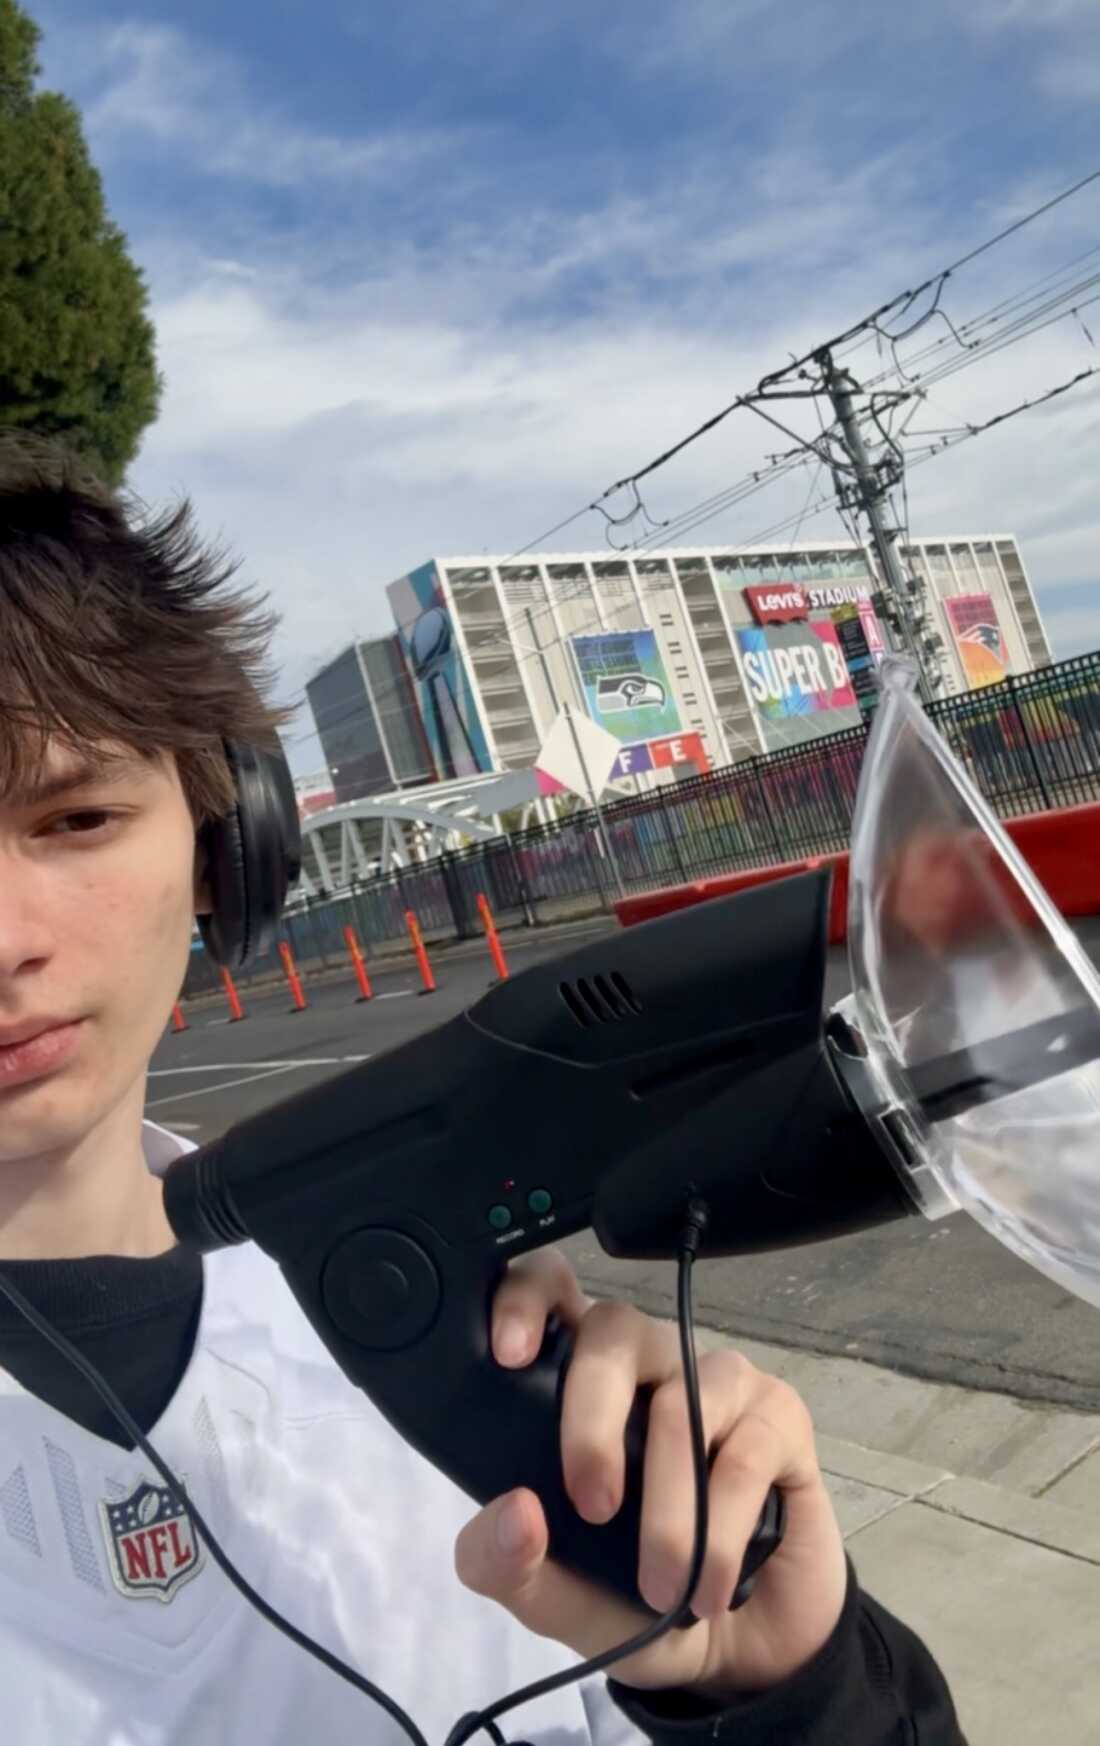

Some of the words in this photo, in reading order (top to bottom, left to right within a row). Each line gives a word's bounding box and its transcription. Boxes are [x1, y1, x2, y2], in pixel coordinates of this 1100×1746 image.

[810, 586, 869, 607] STADIUM
[743, 645, 828, 703] SUPER
[121, 1522, 192, 1579] NFL
